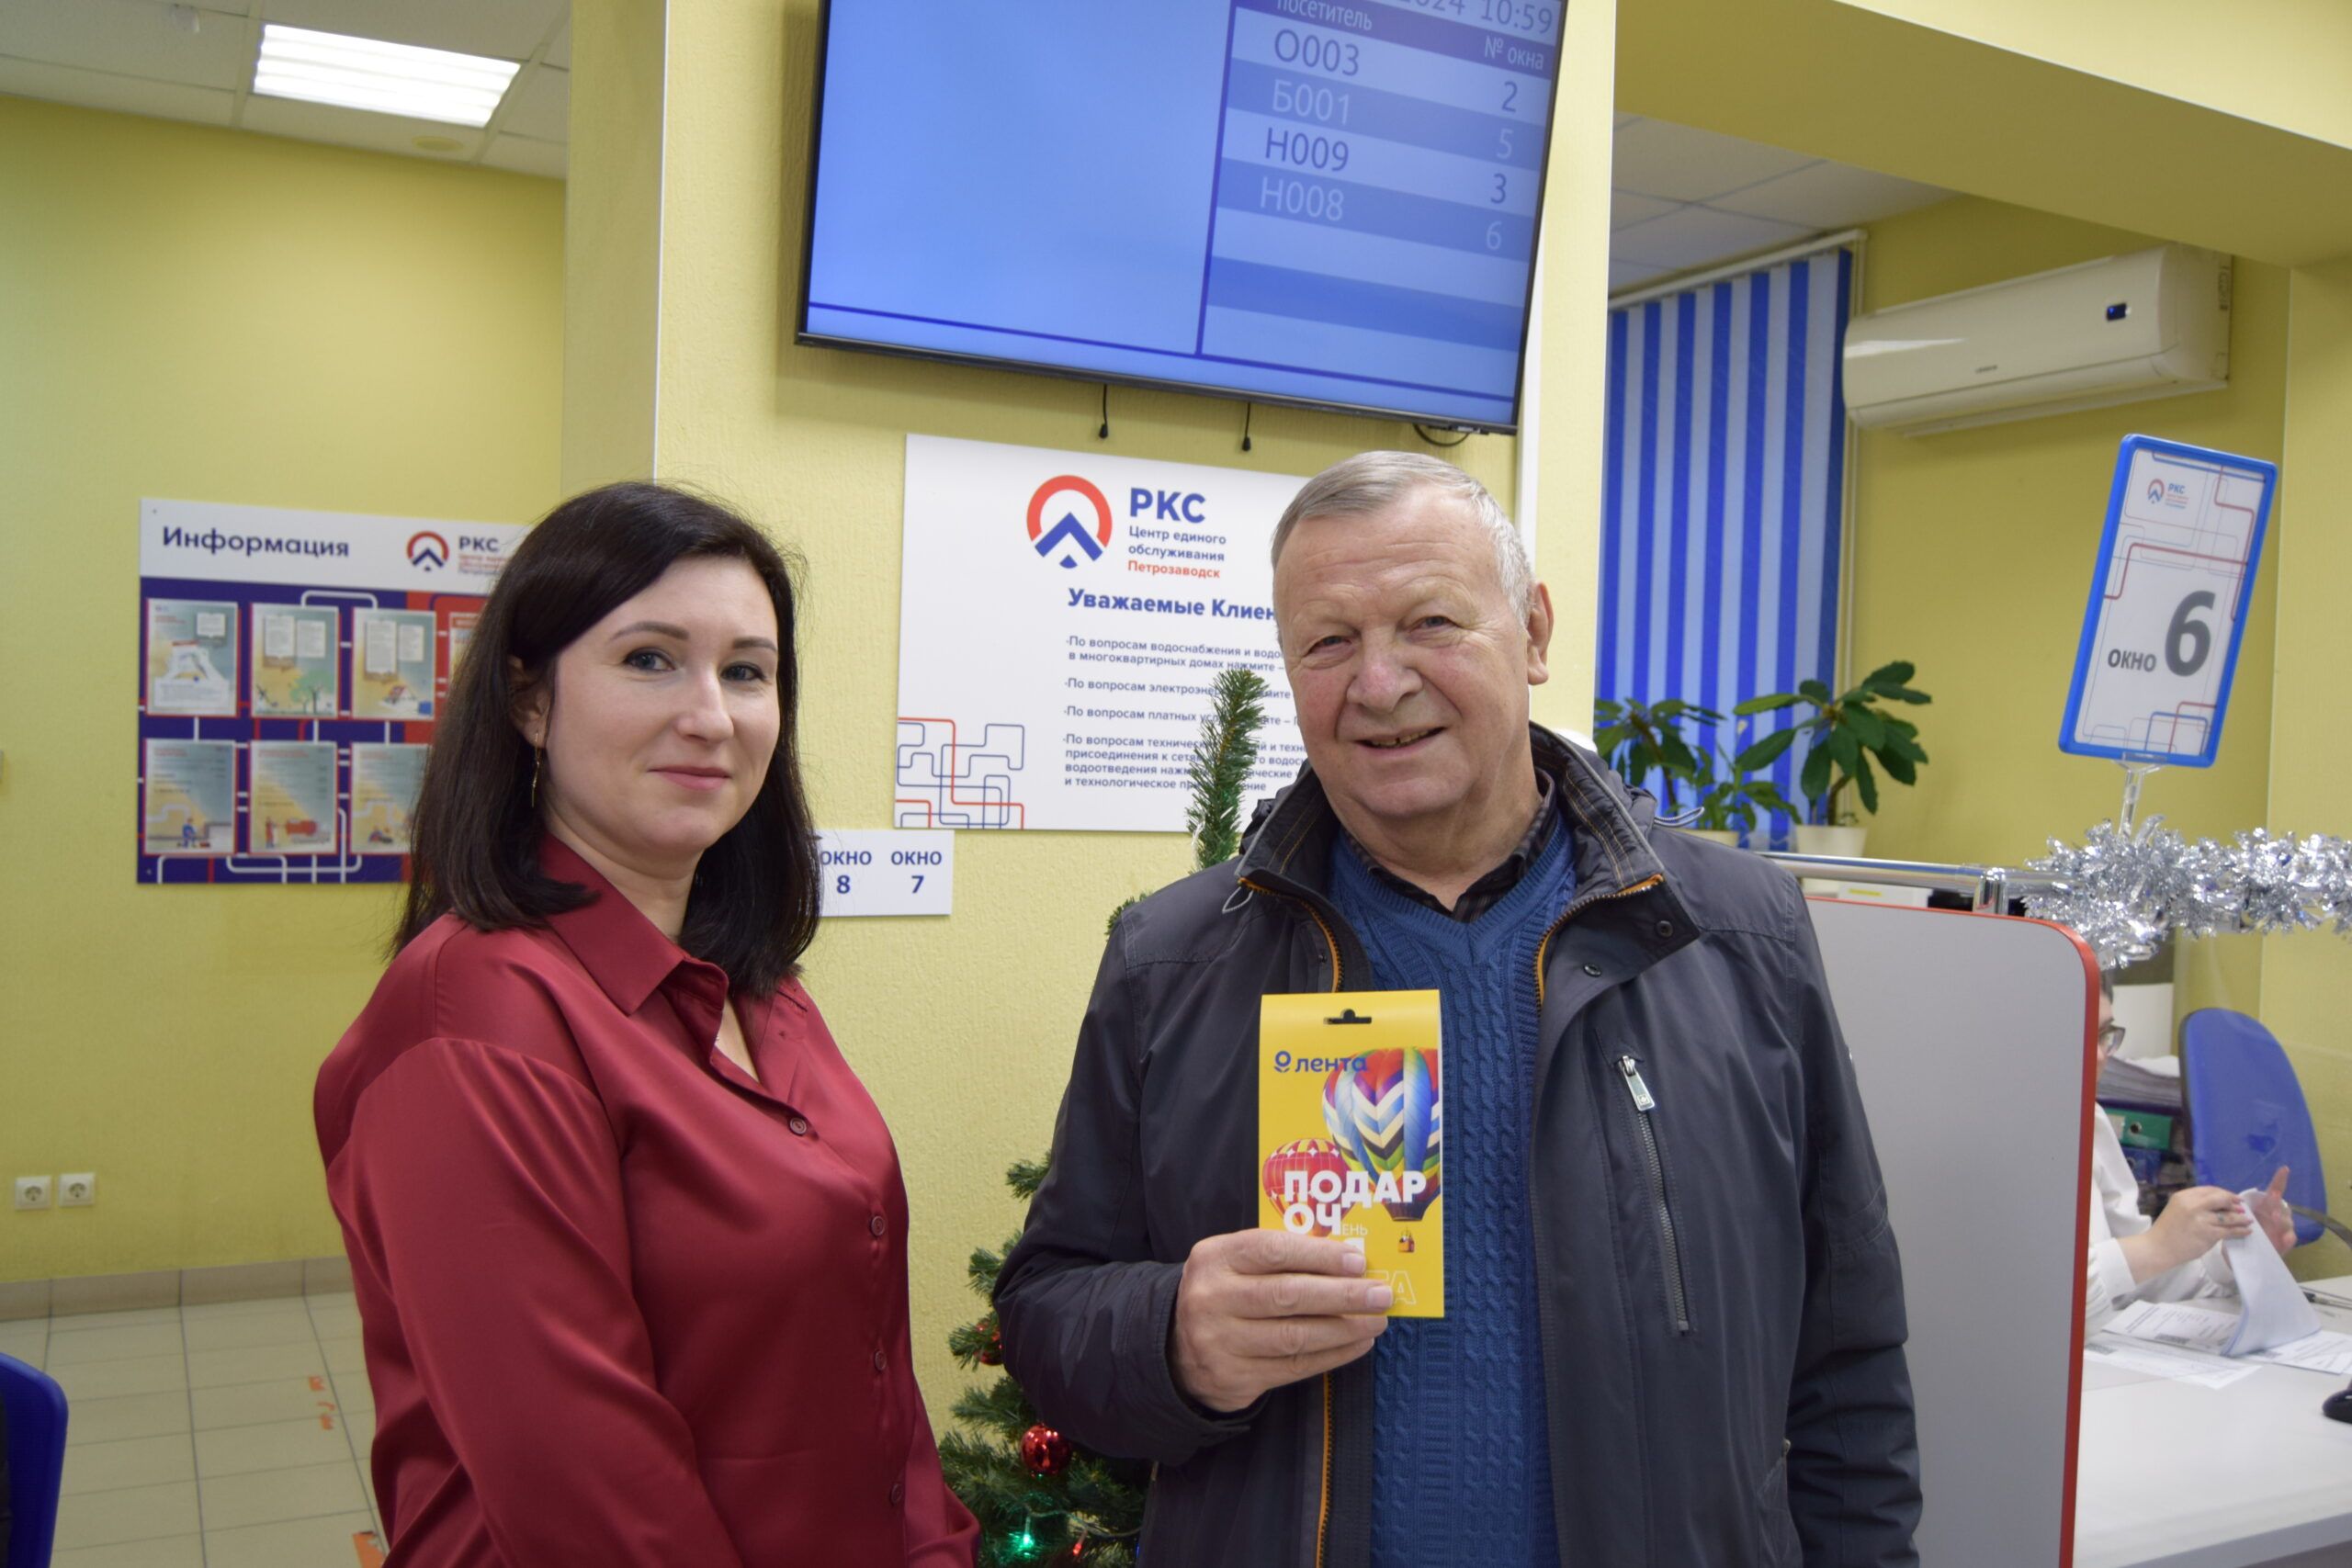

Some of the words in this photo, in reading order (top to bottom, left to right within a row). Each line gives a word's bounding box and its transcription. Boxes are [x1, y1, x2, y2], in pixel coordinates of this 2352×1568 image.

[1480, 0, 1553, 34] 10:59
[1507, 47, 1544, 70] окна
[1501, 80, 1518, 112] 2
[1272, 79, 1349, 125] Б001
[1497, 128, 1513, 159] 5
[1265, 127, 1349, 172] Н009
[1490, 173, 1507, 204] 3
[1260, 176, 1344, 221] Н008
[1486, 220, 1502, 250] 6
[1129, 487, 1206, 524] РКС
[163, 525, 349, 558] Информация
[458, 536, 500, 552] РКС
[1128, 525, 1170, 541] Центр
[1173, 532, 1227, 545] единого
[1128, 545, 1225, 561] обслуживания
[1127, 560, 1221, 579] Петрозаводск
[1068, 588, 1205, 615] Уважаемые
[2165, 590, 2216, 677] 6
[1089, 639, 1147, 650] вопросам
[1150, 643, 1241, 656] водоснабжения
[1080, 652, 1186, 667] многоквартирных
[1189, 659, 1224, 668] домах
[1227, 662, 1275, 671] нажмите
[1088, 681, 1146, 692] вопросам
[1087, 708, 1145, 719] вопросам
[1148, 712, 1197, 721] платных
[1086, 737, 1144, 747] вопросам
[1066, 750, 1159, 761] присоединения
[1161, 752, 1168, 761] к
[1065, 763, 1158, 774] водоотведения
[1075, 778, 1176, 788] технологическое
[891, 851, 943, 865] ОКНО
[836, 874, 851, 894] 8
[911, 874, 924, 894] 7
[1295, 1057, 1368, 1073] лента
[1283, 1169, 1427, 1209] ПОДАР
